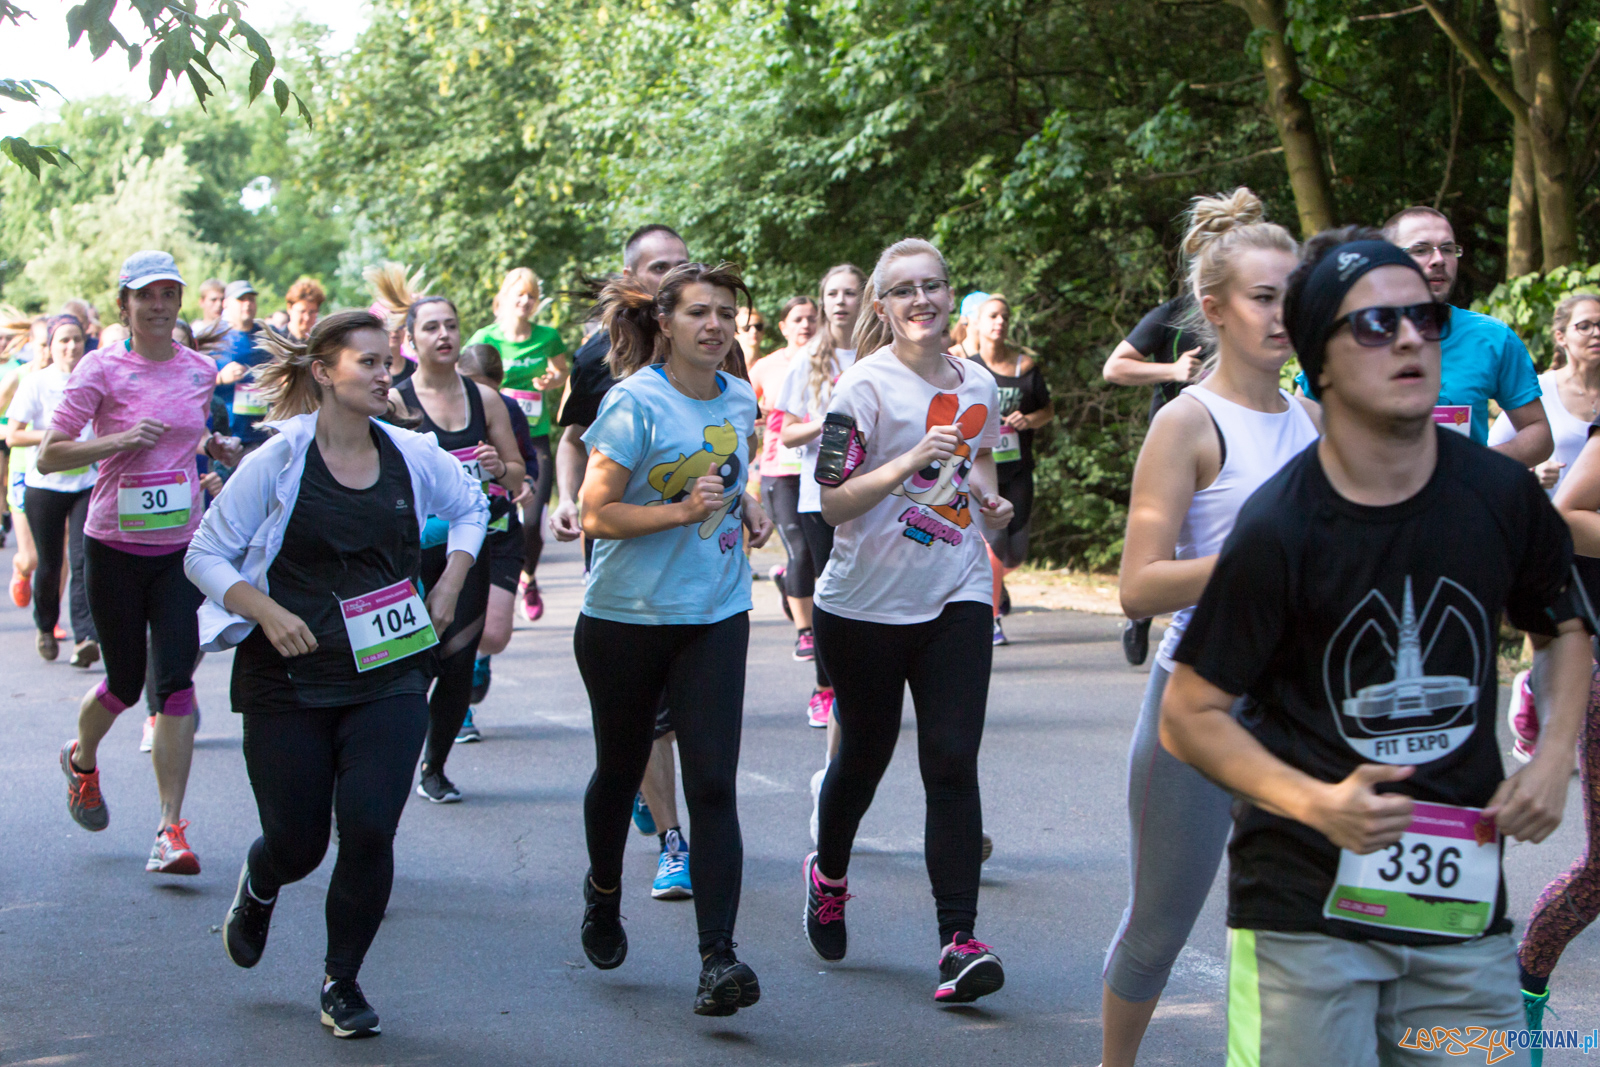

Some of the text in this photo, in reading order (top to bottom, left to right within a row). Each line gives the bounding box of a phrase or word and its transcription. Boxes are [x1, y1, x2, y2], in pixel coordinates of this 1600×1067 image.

[142, 489, 168, 509] 30
[903, 528, 932, 546] GIRLS
[372, 602, 417, 637] 104
[1375, 733, 1449, 756] FIT EXPO
[1378, 841, 1461, 888] 336
